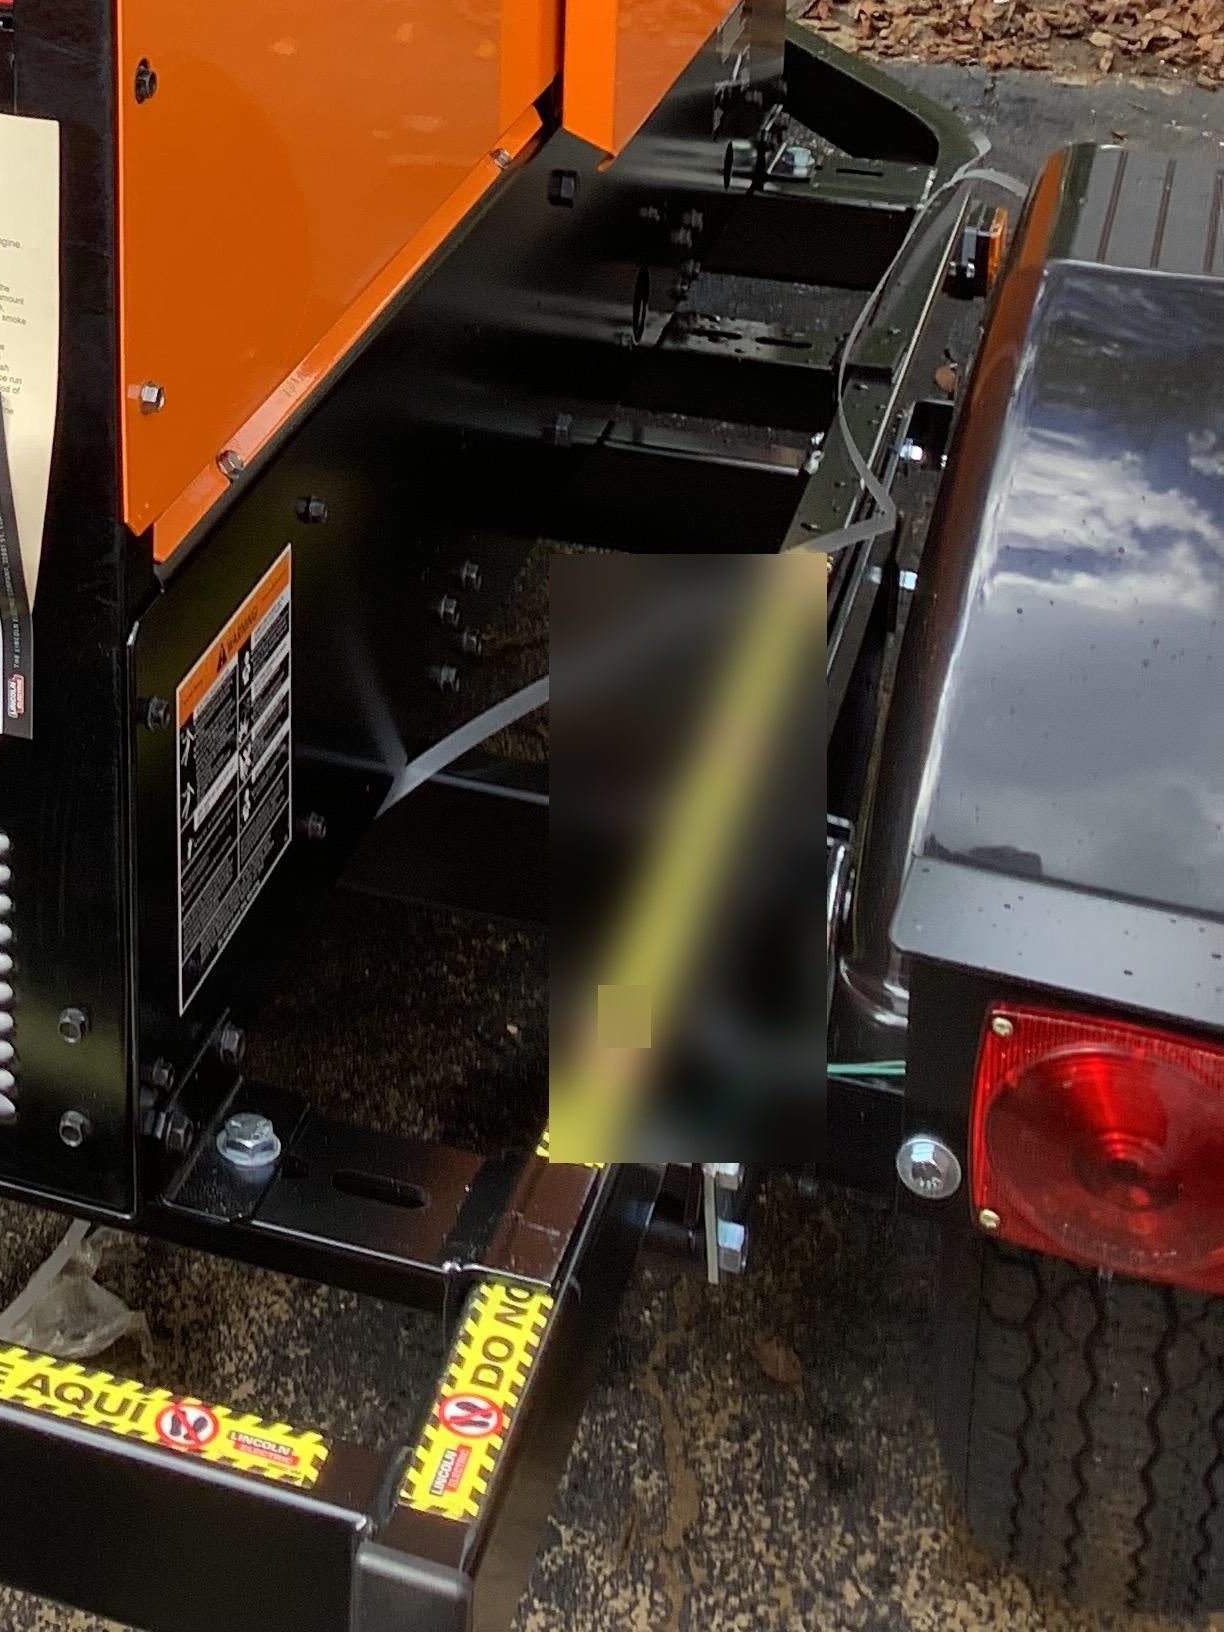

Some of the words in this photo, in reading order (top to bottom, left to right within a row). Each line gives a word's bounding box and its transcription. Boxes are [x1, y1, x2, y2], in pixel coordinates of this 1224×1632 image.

[469, 1334, 515, 1392] DO
[230, 1431, 292, 1456] LINCOLN
[430, 1449, 458, 1496] LINCOLN
